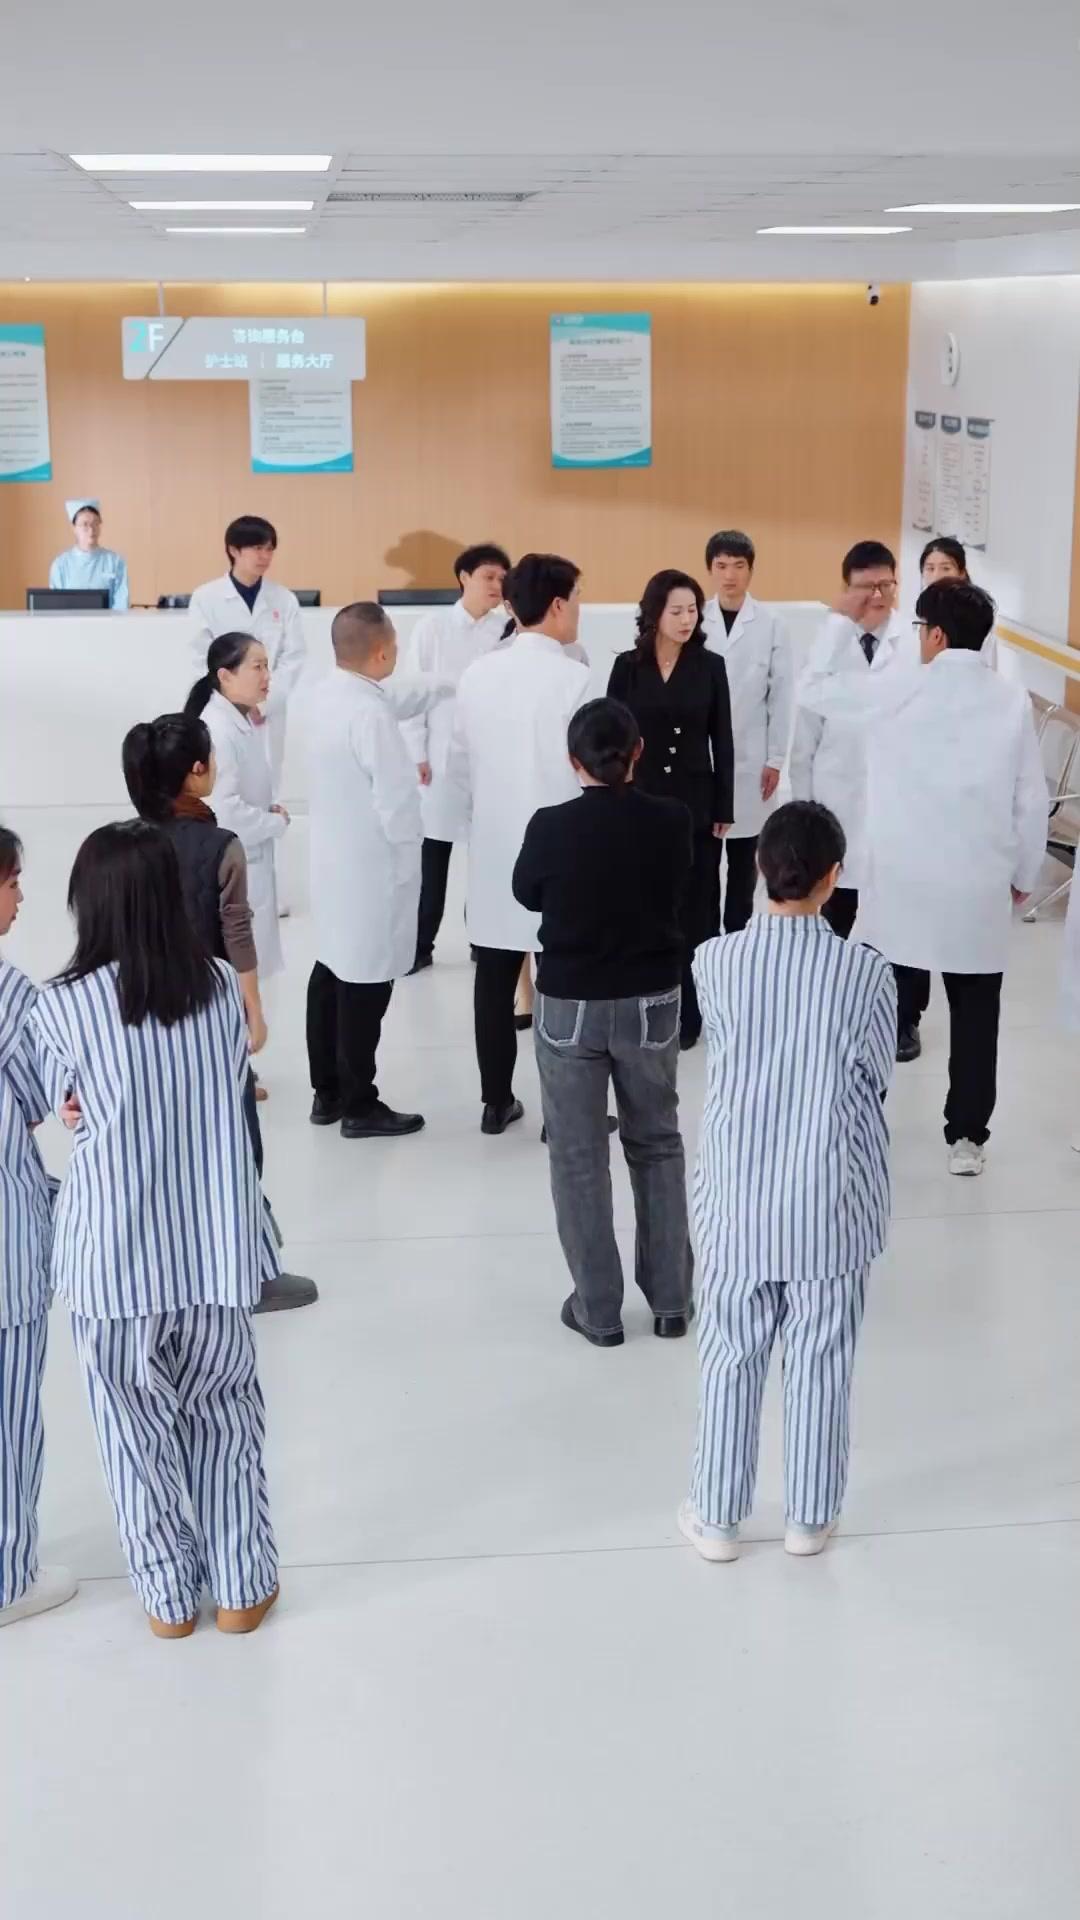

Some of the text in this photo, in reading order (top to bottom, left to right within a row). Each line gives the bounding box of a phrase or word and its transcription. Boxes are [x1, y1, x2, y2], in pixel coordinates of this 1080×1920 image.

[128, 321, 164, 352] 2F
[232, 328, 305, 344] 咨询服务台
[204, 353, 334, 369] 护士站 服务大厅
